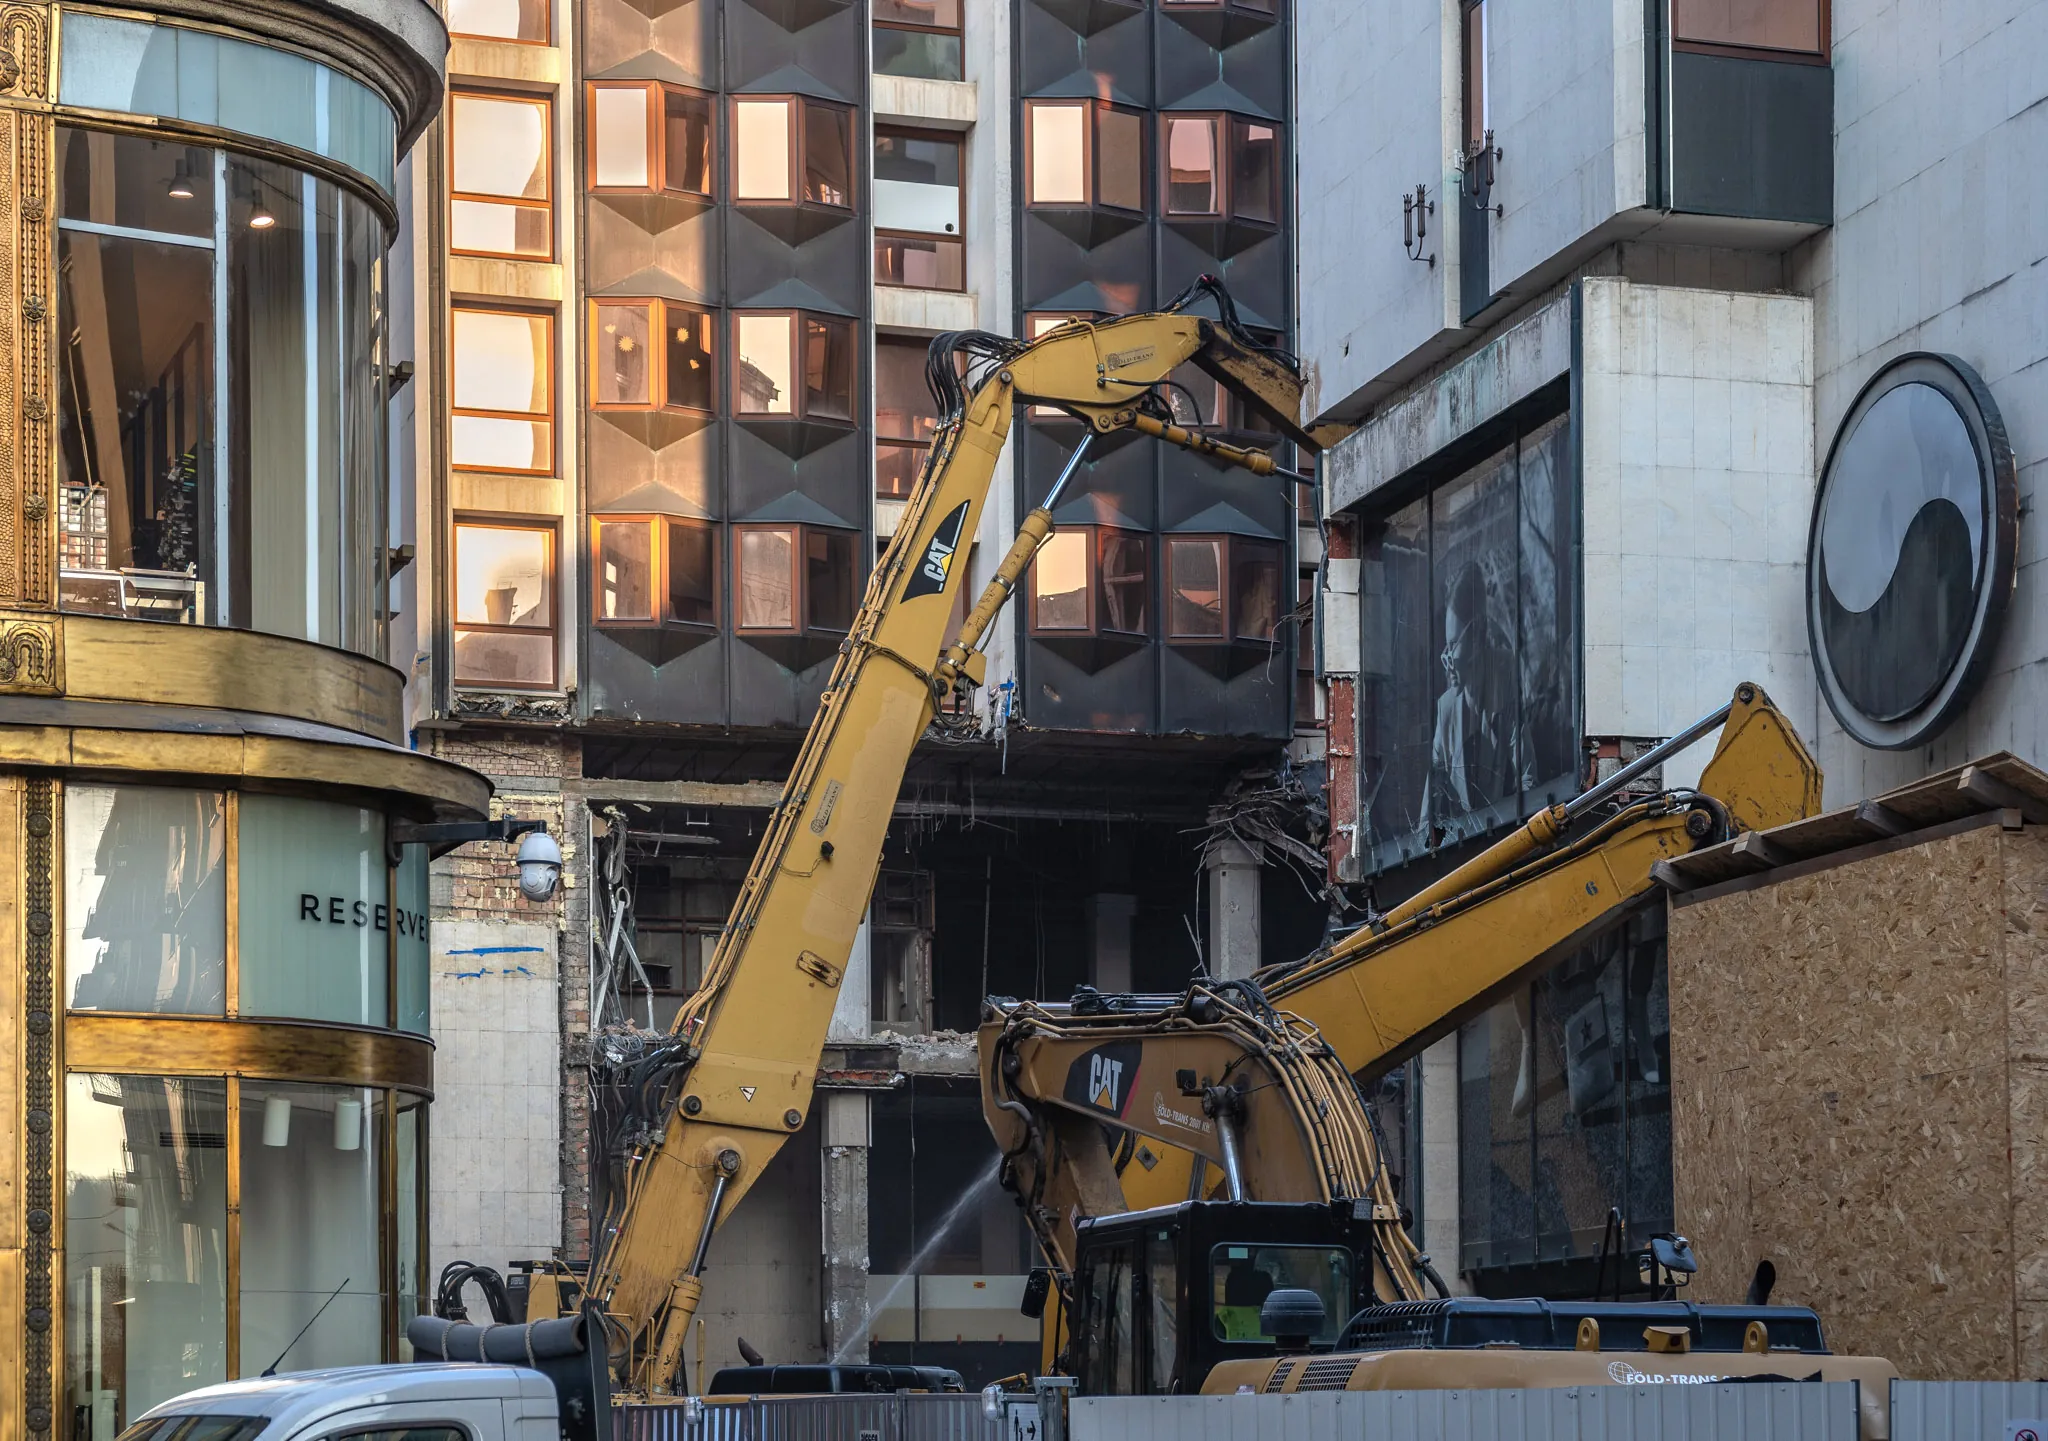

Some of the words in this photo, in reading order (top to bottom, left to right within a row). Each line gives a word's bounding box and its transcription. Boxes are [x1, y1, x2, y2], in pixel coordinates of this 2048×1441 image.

[924, 536, 955, 582] CAT
[1585, 881, 1599, 896] 6
[300, 893, 430, 944] RESERVE
[1089, 1053, 1123, 1111] CAT
